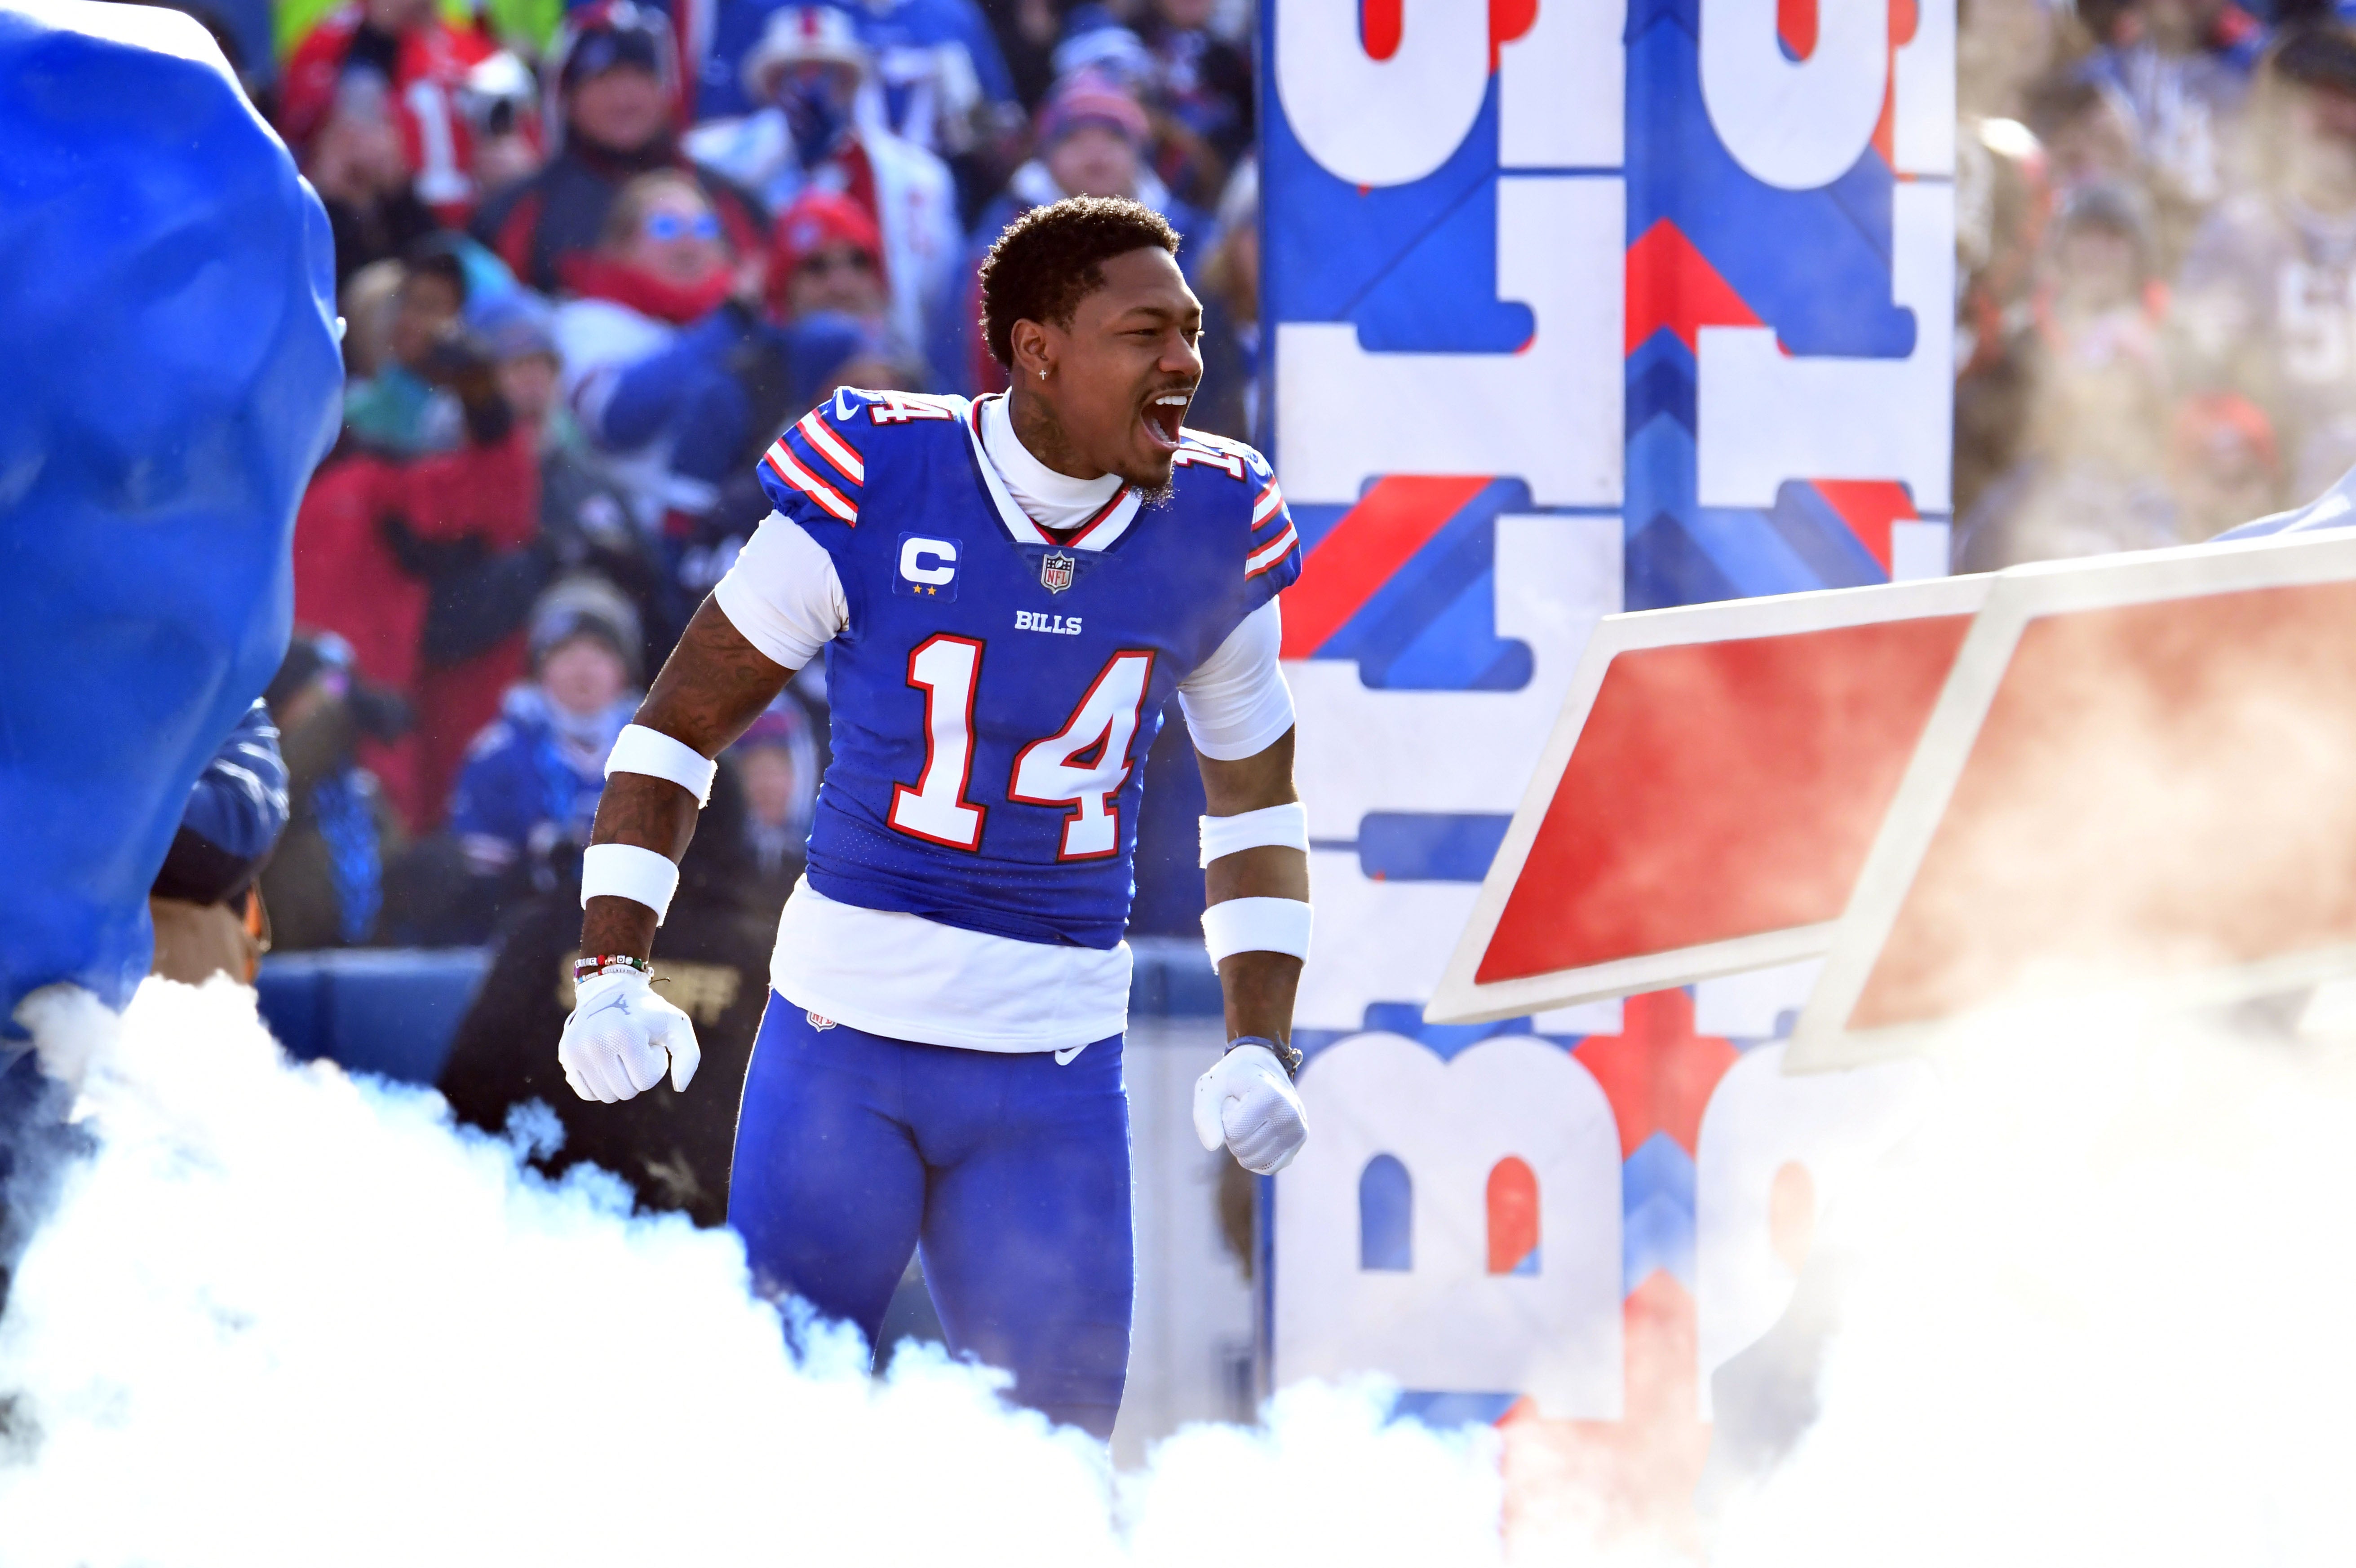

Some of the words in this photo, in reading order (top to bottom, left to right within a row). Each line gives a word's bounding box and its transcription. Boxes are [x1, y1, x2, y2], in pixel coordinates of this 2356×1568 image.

[899, 537, 957, 585] C
[1047, 570, 1067, 586] NFL
[1014, 610, 1082, 636] BILLS
[886, 631, 1158, 863] 14
